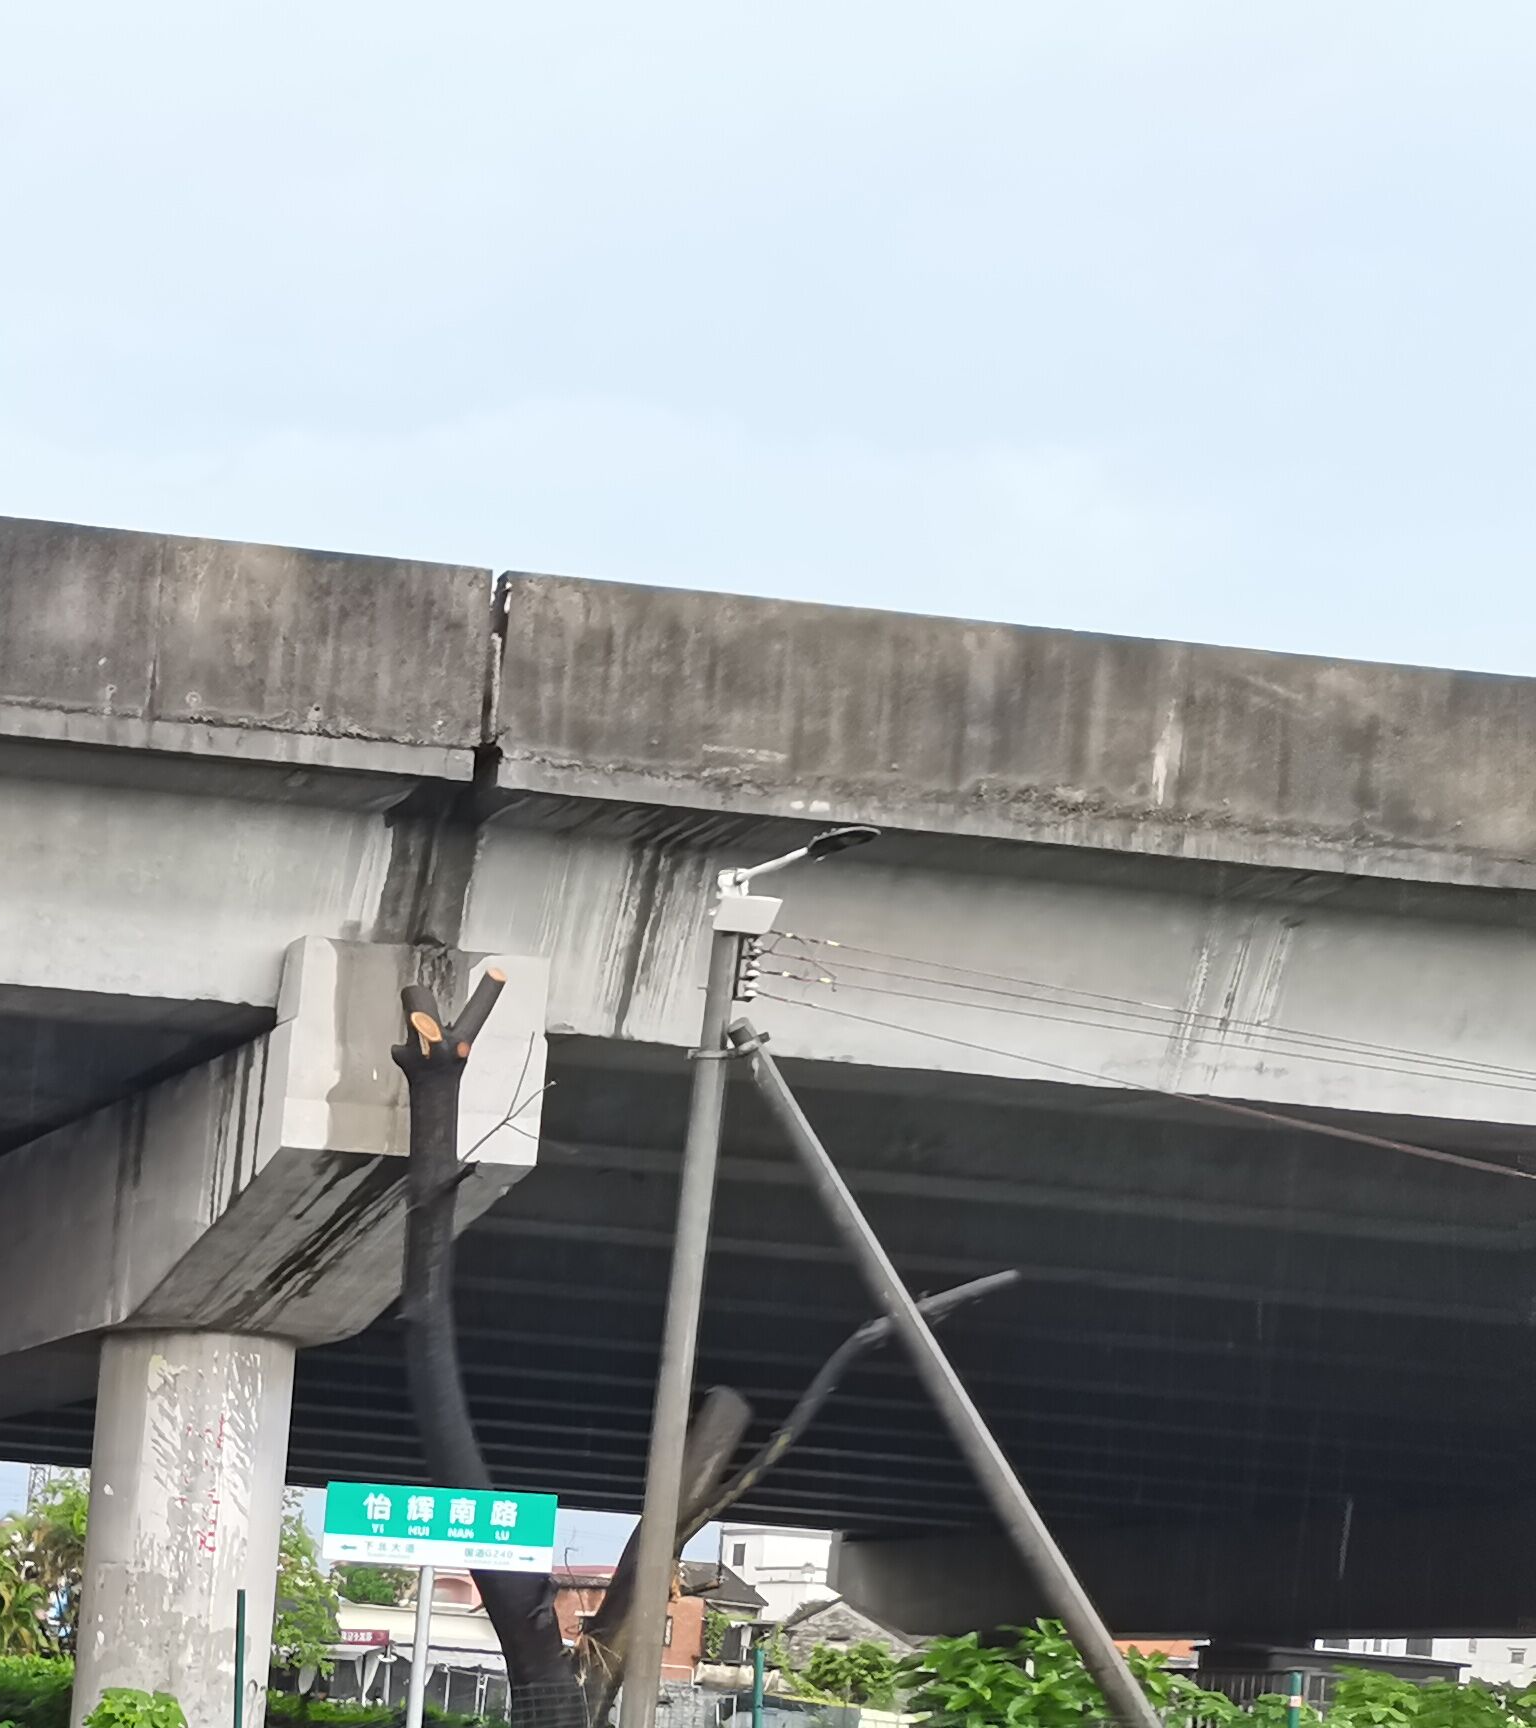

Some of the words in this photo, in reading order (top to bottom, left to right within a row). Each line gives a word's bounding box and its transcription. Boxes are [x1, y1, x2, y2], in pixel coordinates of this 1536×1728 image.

[362, 1492, 518, 1528] 怡辉南路
[371, 1523, 384, 1534] YI
[408, 1526, 431, 1537] HUI
[447, 1528, 475, 1540] NAN
[495, 1530, 510, 1542] LU
